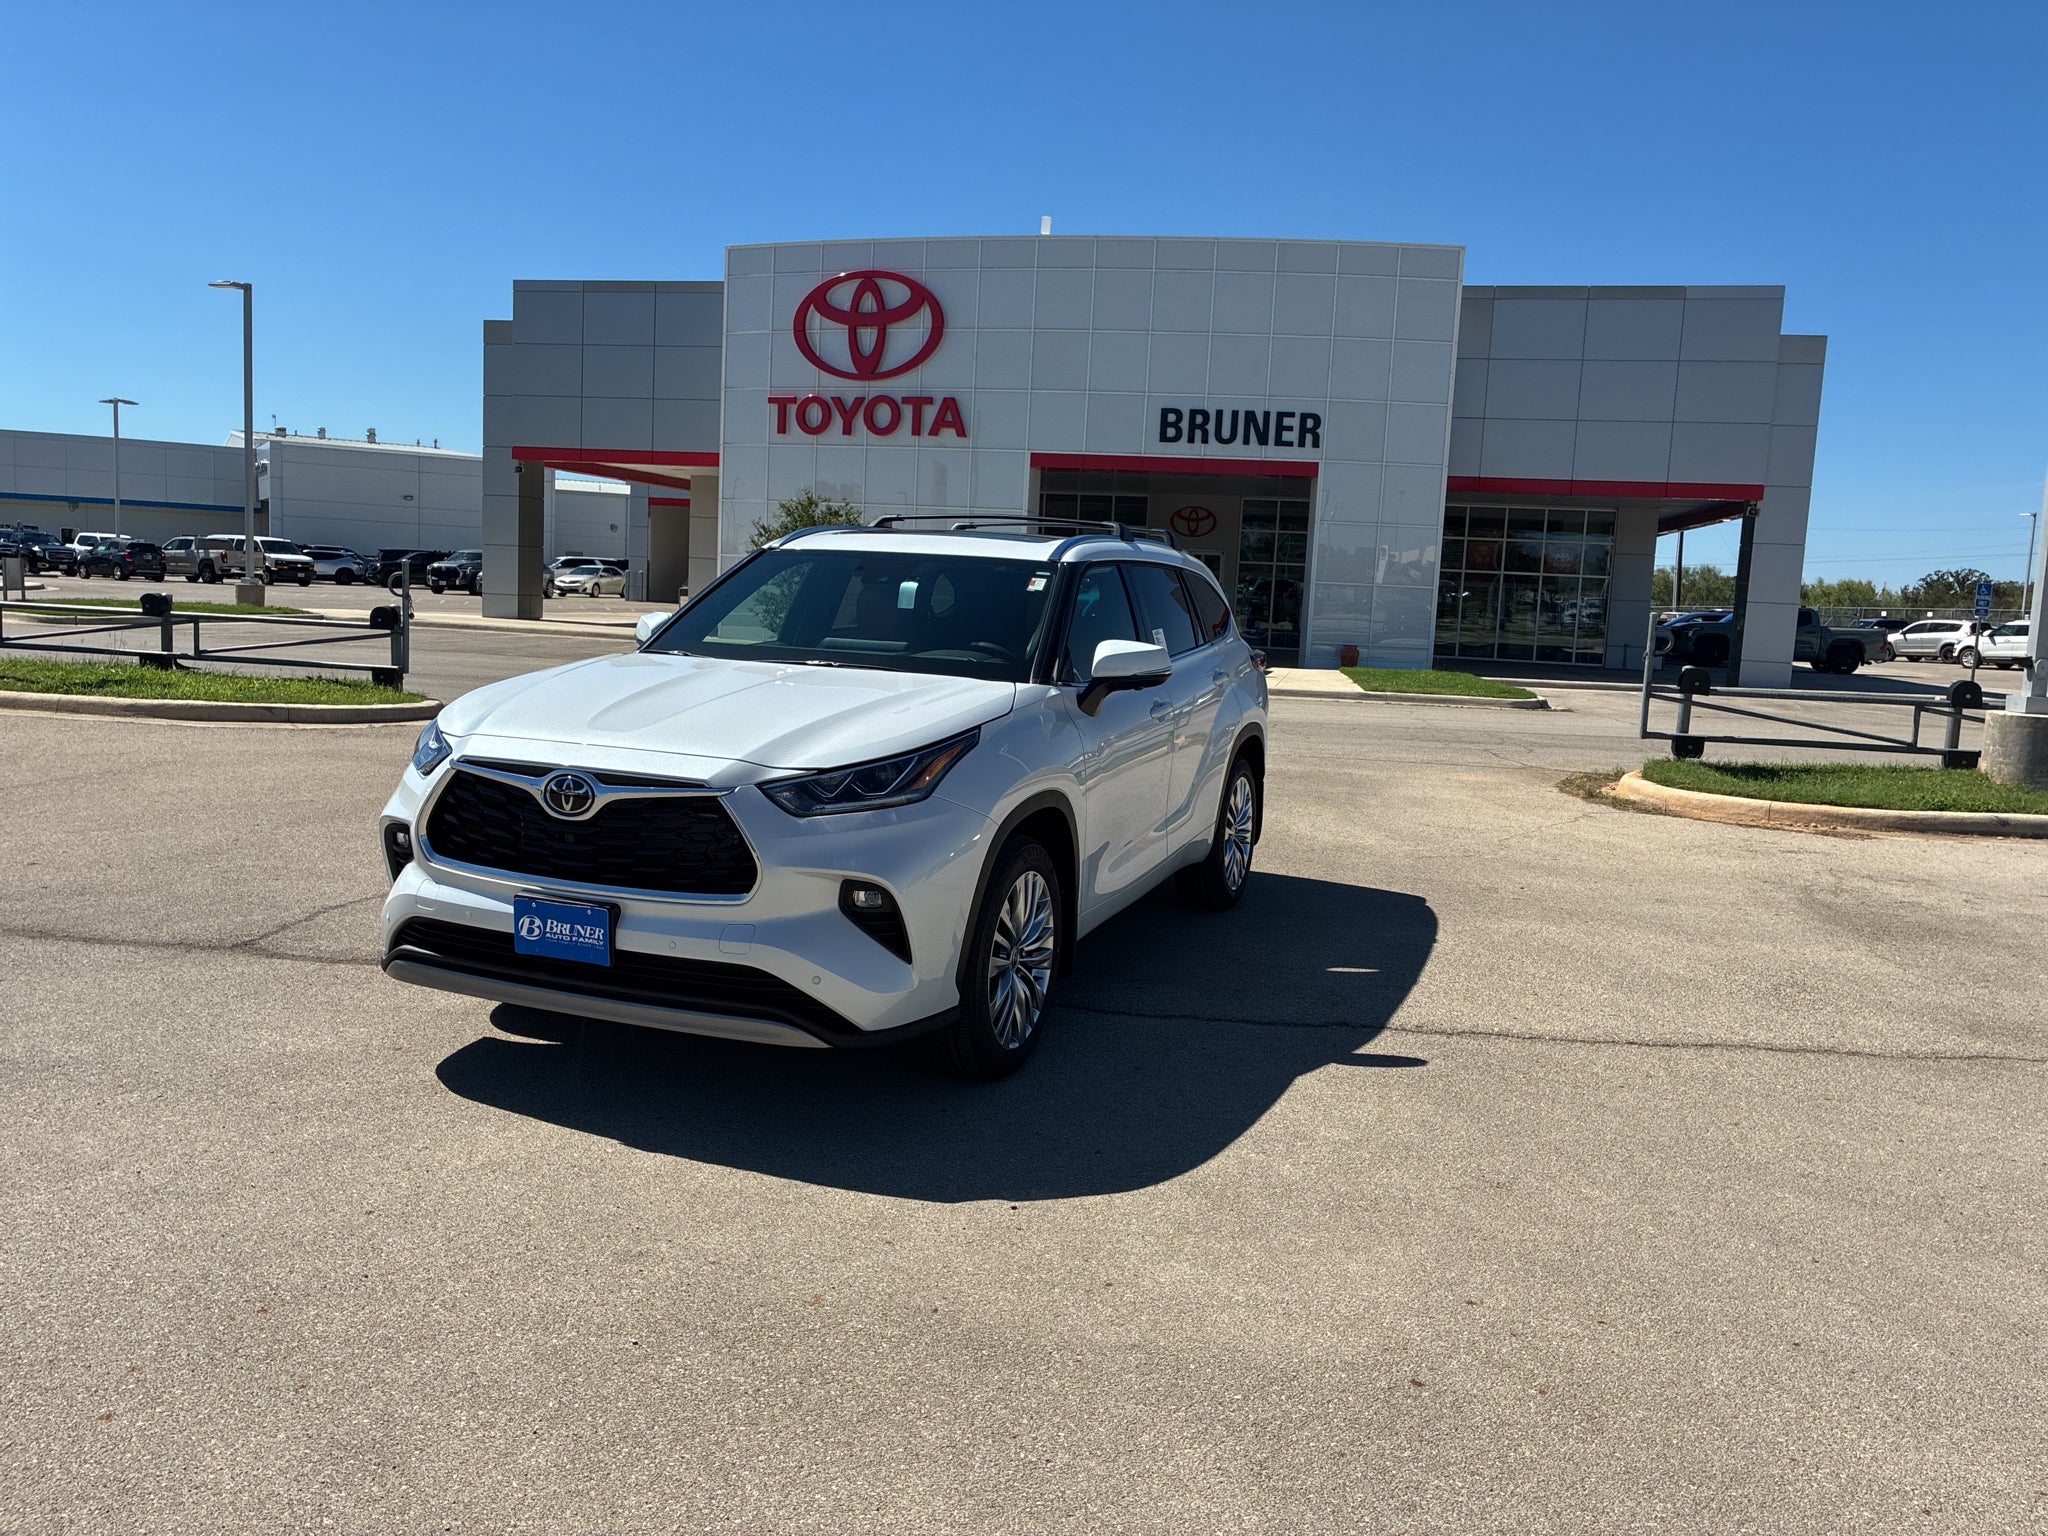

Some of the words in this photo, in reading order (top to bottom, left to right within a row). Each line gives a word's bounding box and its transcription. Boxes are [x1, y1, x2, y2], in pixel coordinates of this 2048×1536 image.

[767, 394, 967, 438] TOYOTA
[1159, 407, 1322, 448] BRUNER
[545, 933, 571, 941] AUTO
[572, 936, 605, 946] FAMILY
